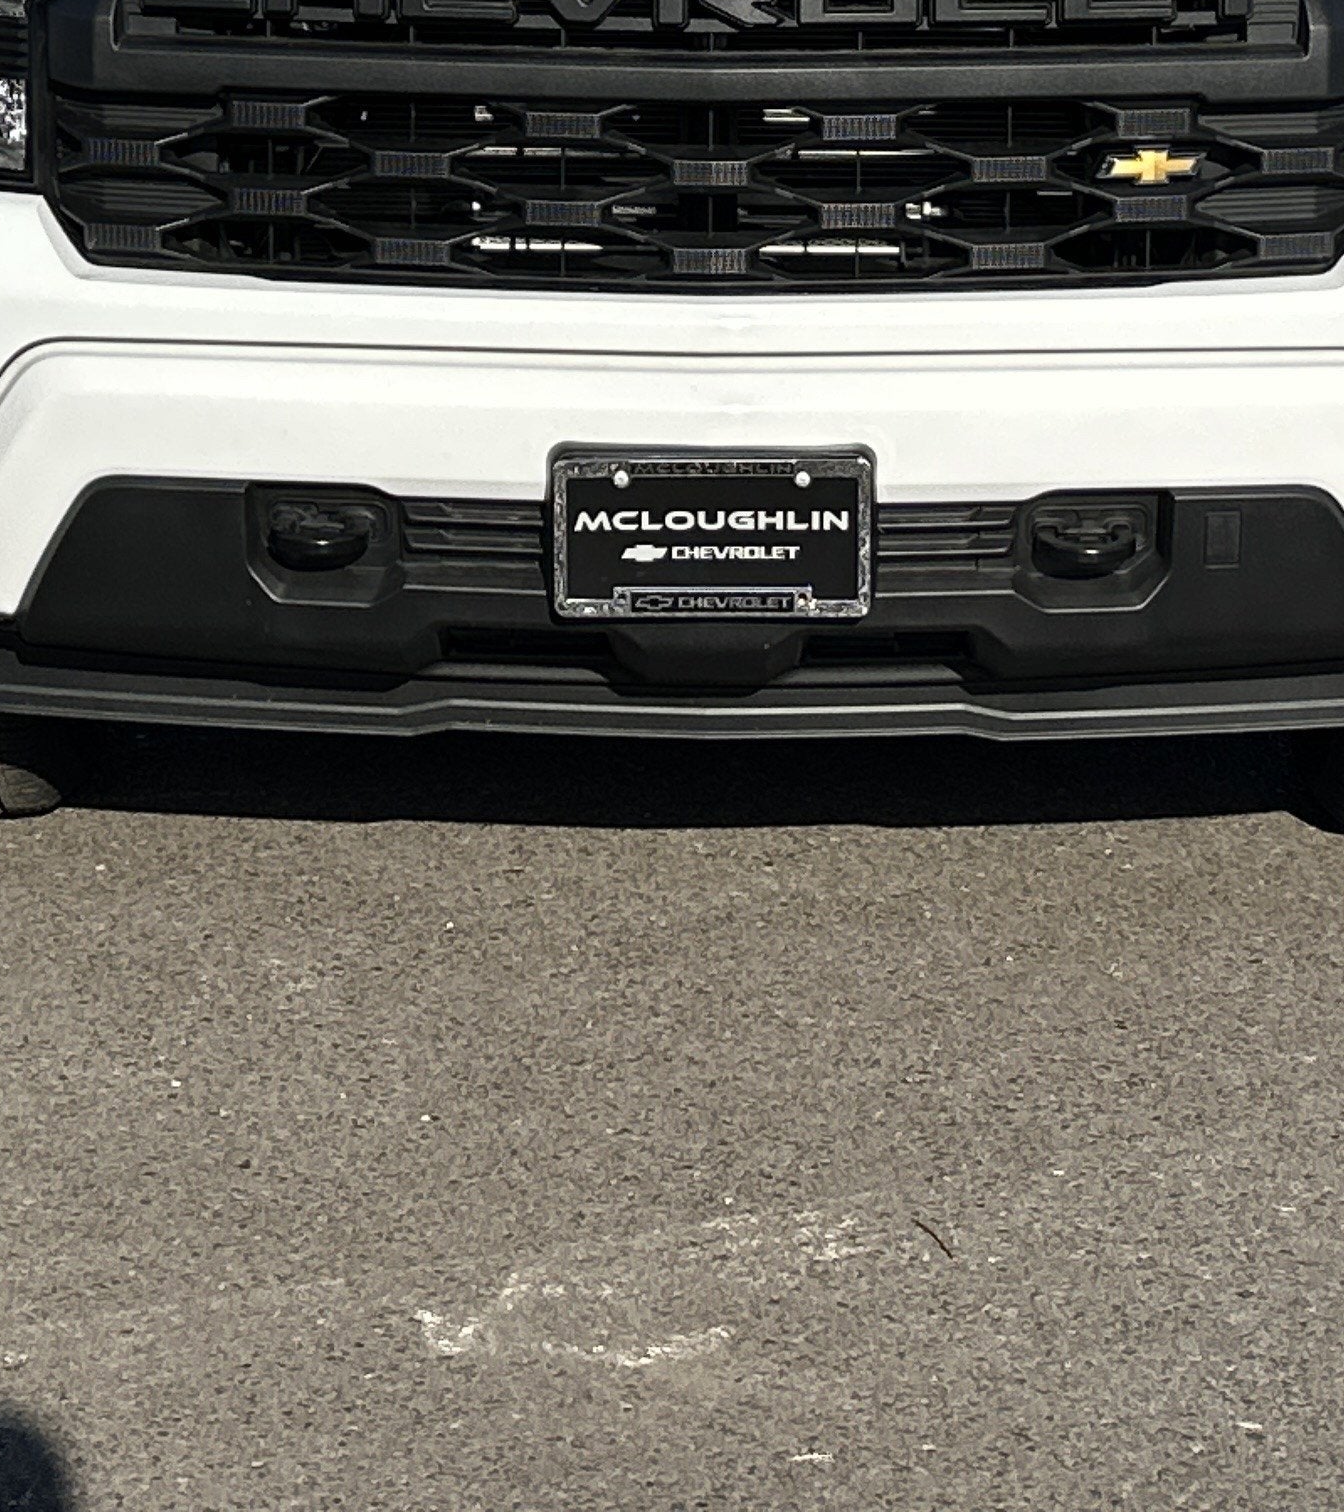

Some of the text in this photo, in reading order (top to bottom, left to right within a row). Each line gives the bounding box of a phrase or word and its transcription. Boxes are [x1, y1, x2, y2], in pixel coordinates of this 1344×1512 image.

[573, 510, 850, 532] MCLOUGHLIN
[671, 545, 801, 560] CHEVROLET
[678, 595, 791, 610] CHEVROLET
